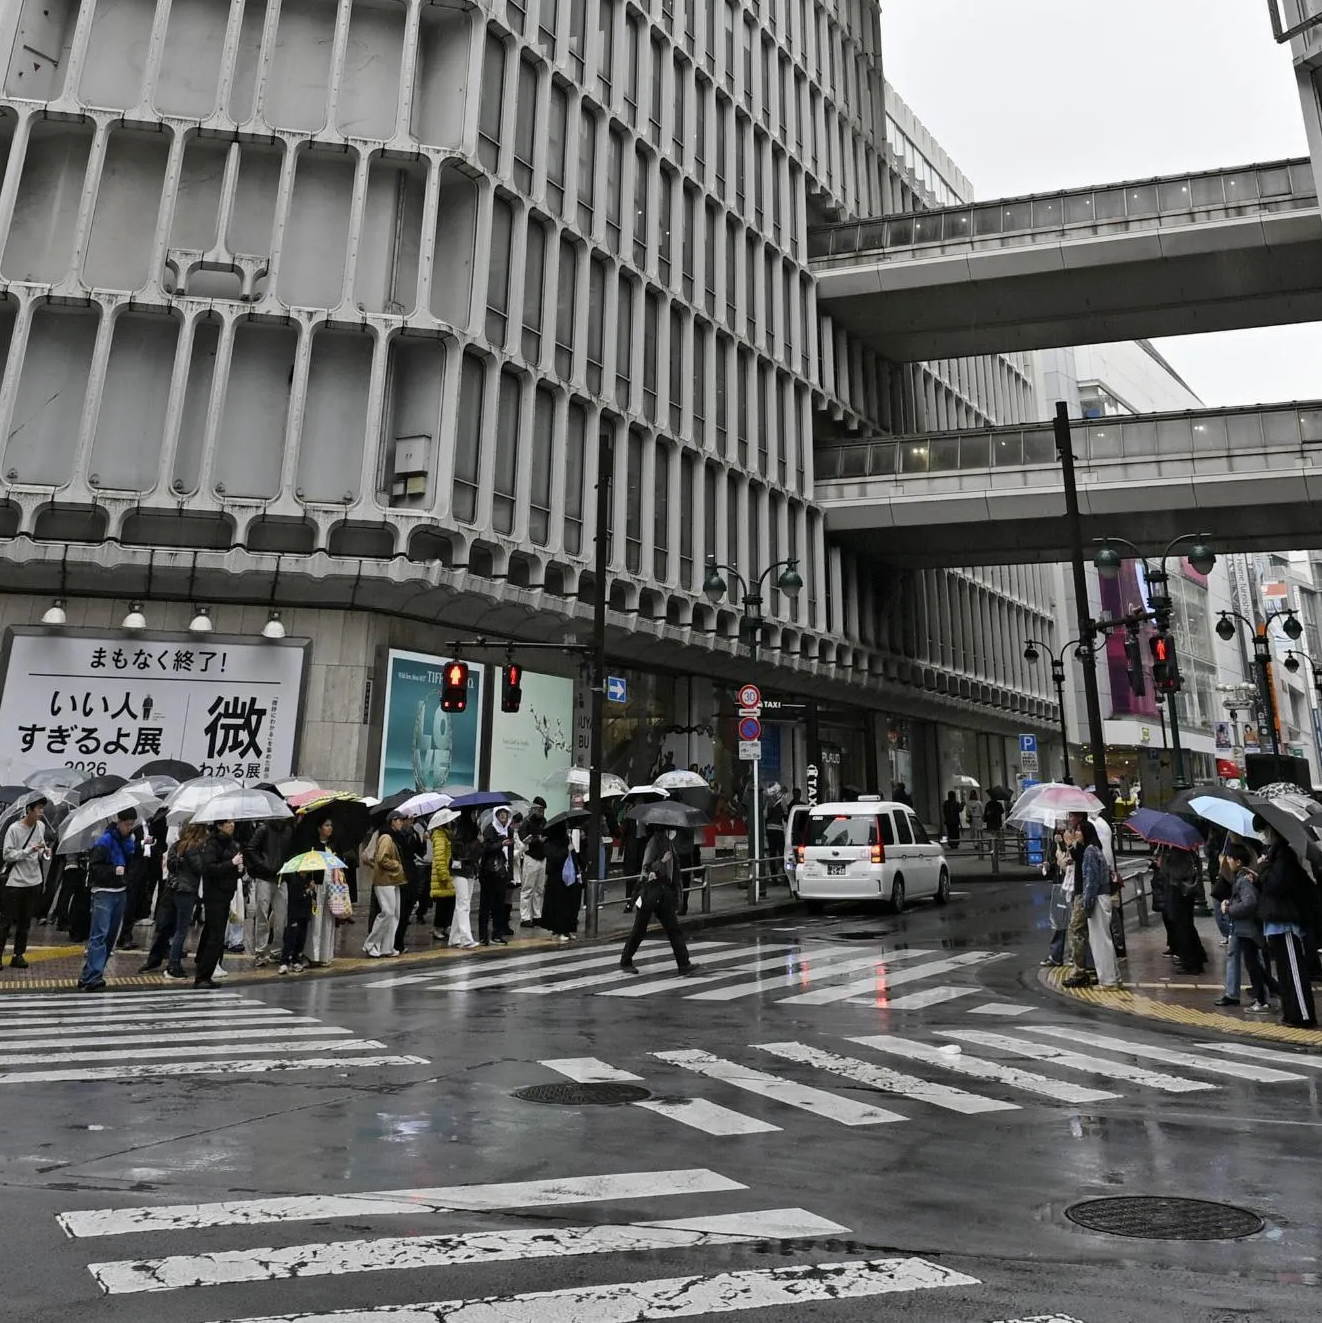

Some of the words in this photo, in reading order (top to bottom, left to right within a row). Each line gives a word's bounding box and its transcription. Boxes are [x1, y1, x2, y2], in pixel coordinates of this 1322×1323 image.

[50, 690, 138, 720] いい人
[744, 691, 755, 702] 30
[764, 701, 781, 709] TAXI
[204, 695, 267, 759] 微
[17, 723, 163, 756] すぎるよ展
[1023, 736, 1034, 750] P
[64, 761, 107, 777] 2026
[199, 761, 261, 779] わかる展
[808, 779, 819, 807] TAX
